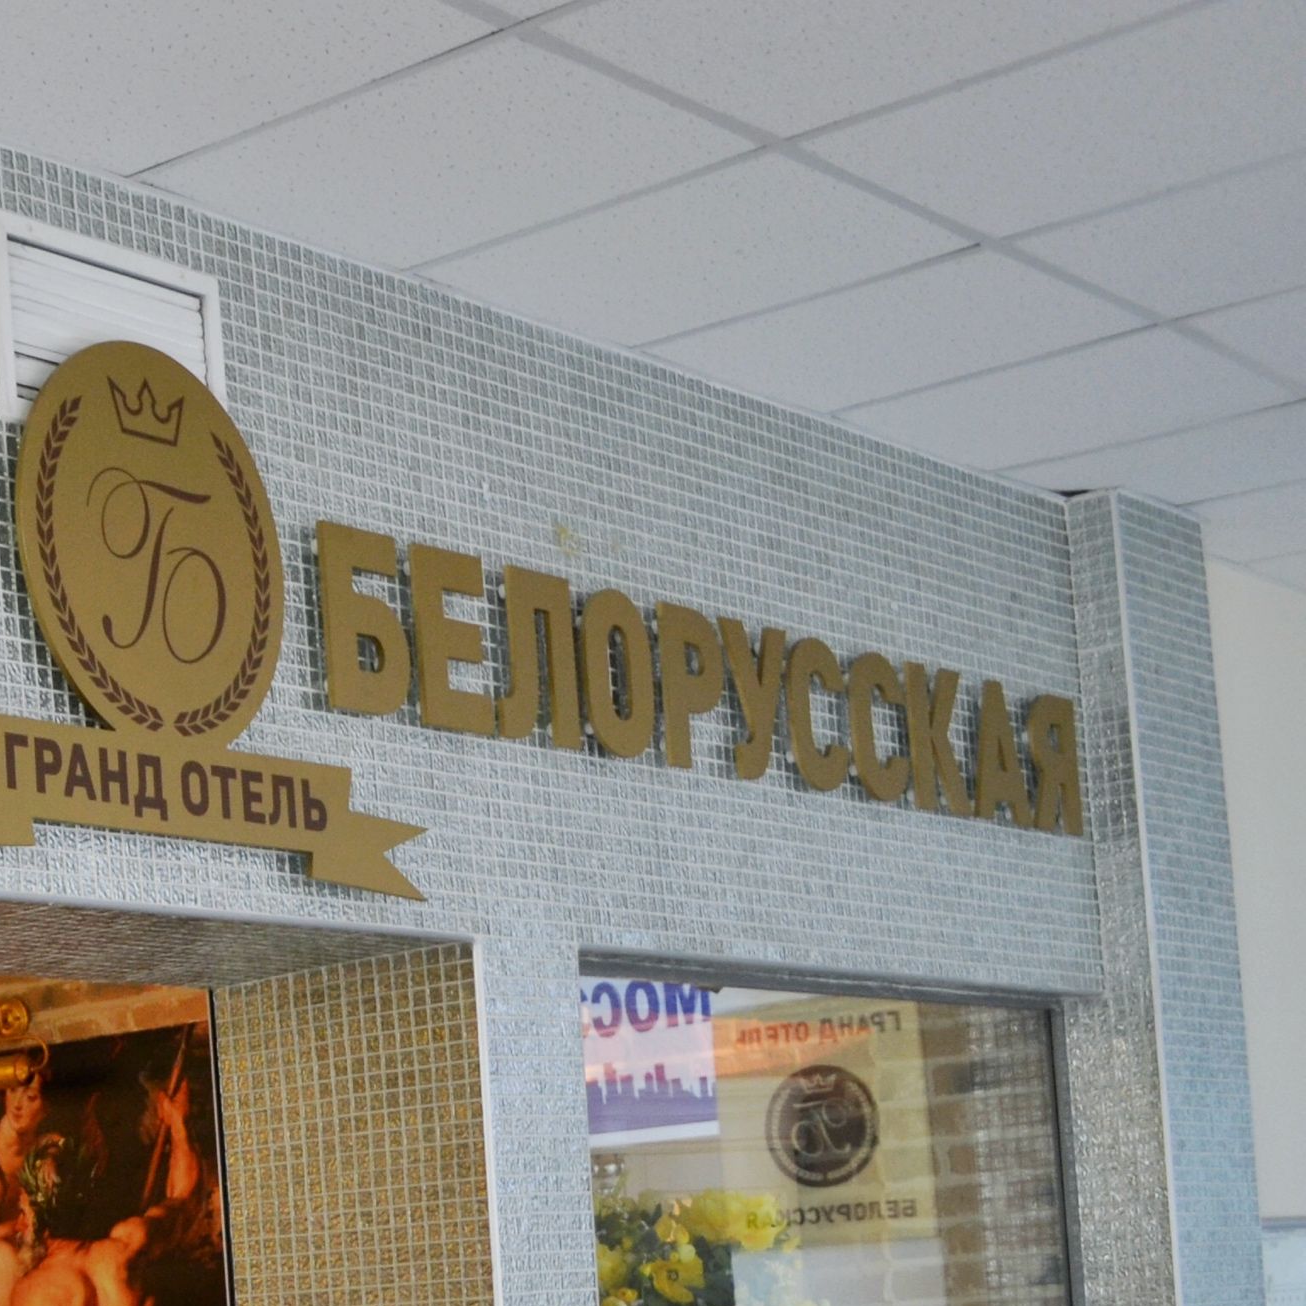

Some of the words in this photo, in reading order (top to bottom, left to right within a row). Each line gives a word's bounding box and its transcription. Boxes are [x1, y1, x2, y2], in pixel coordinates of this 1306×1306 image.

[3, 731, 169, 822] ГРАНД
[180, 760, 328, 832] ОТЕЛЬ
[316, 519, 1083, 837] БЕЛОРУССКАЯ
